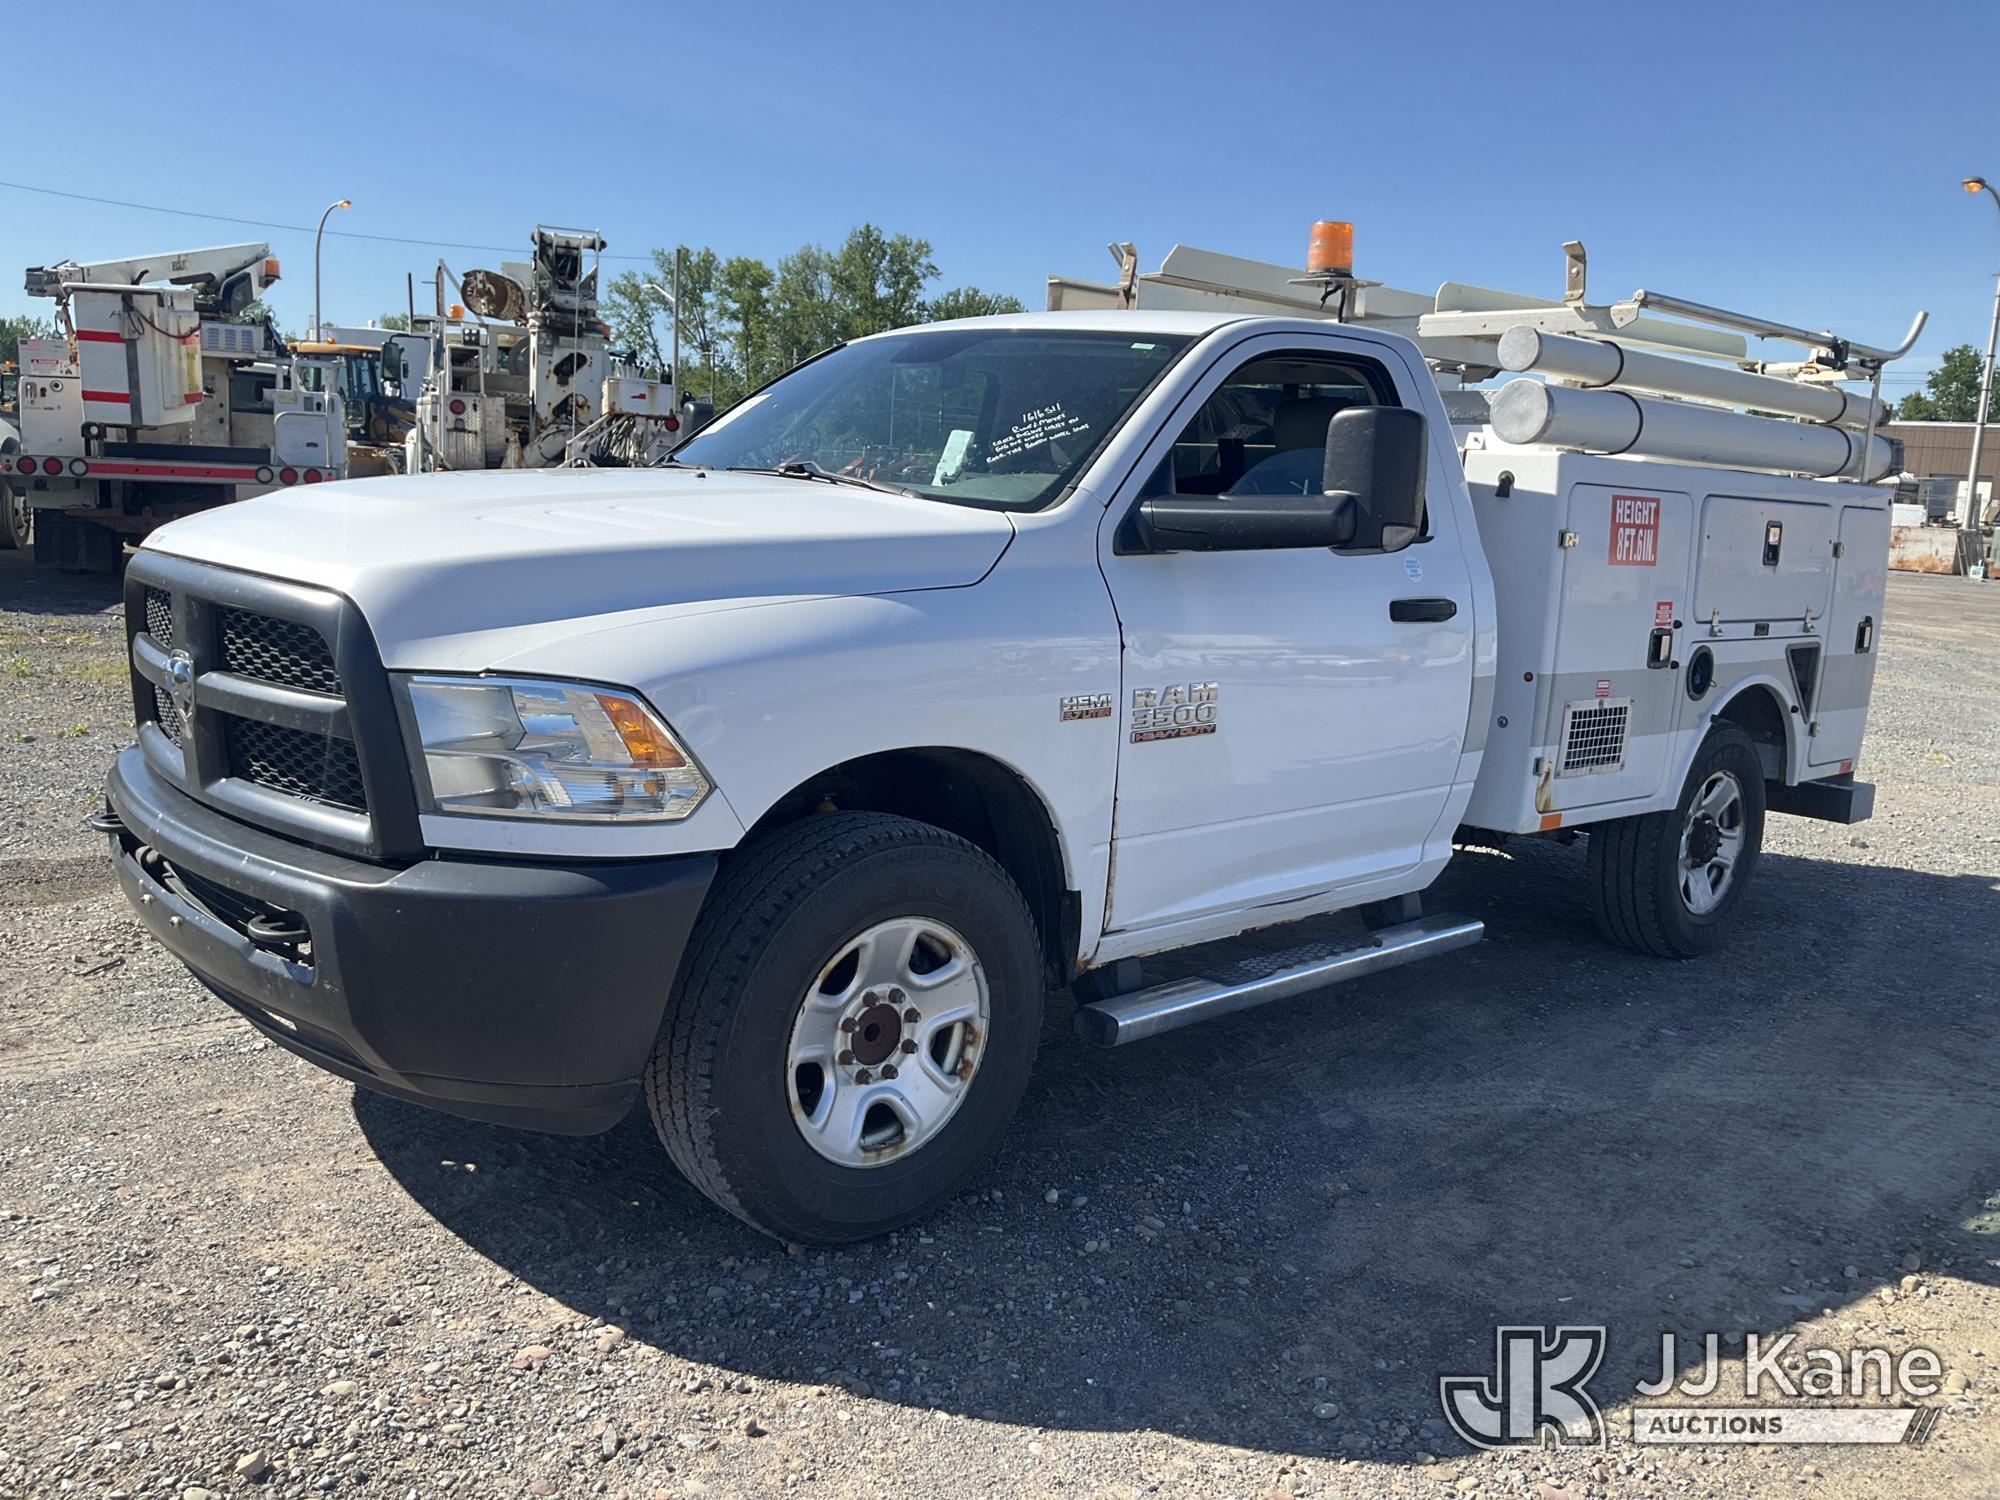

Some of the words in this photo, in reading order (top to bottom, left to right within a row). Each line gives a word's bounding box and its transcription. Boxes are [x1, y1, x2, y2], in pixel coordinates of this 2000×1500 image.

[1616, 499, 1656, 524] HEIGHT
[1061, 693, 1112, 709] HEMI
[1133, 681, 1218, 708] RAM
[1131, 702, 1217, 728] 3500
[1135, 729, 1179, 741] HEAVY
[1179, 724, 1214, 736] DUTY
